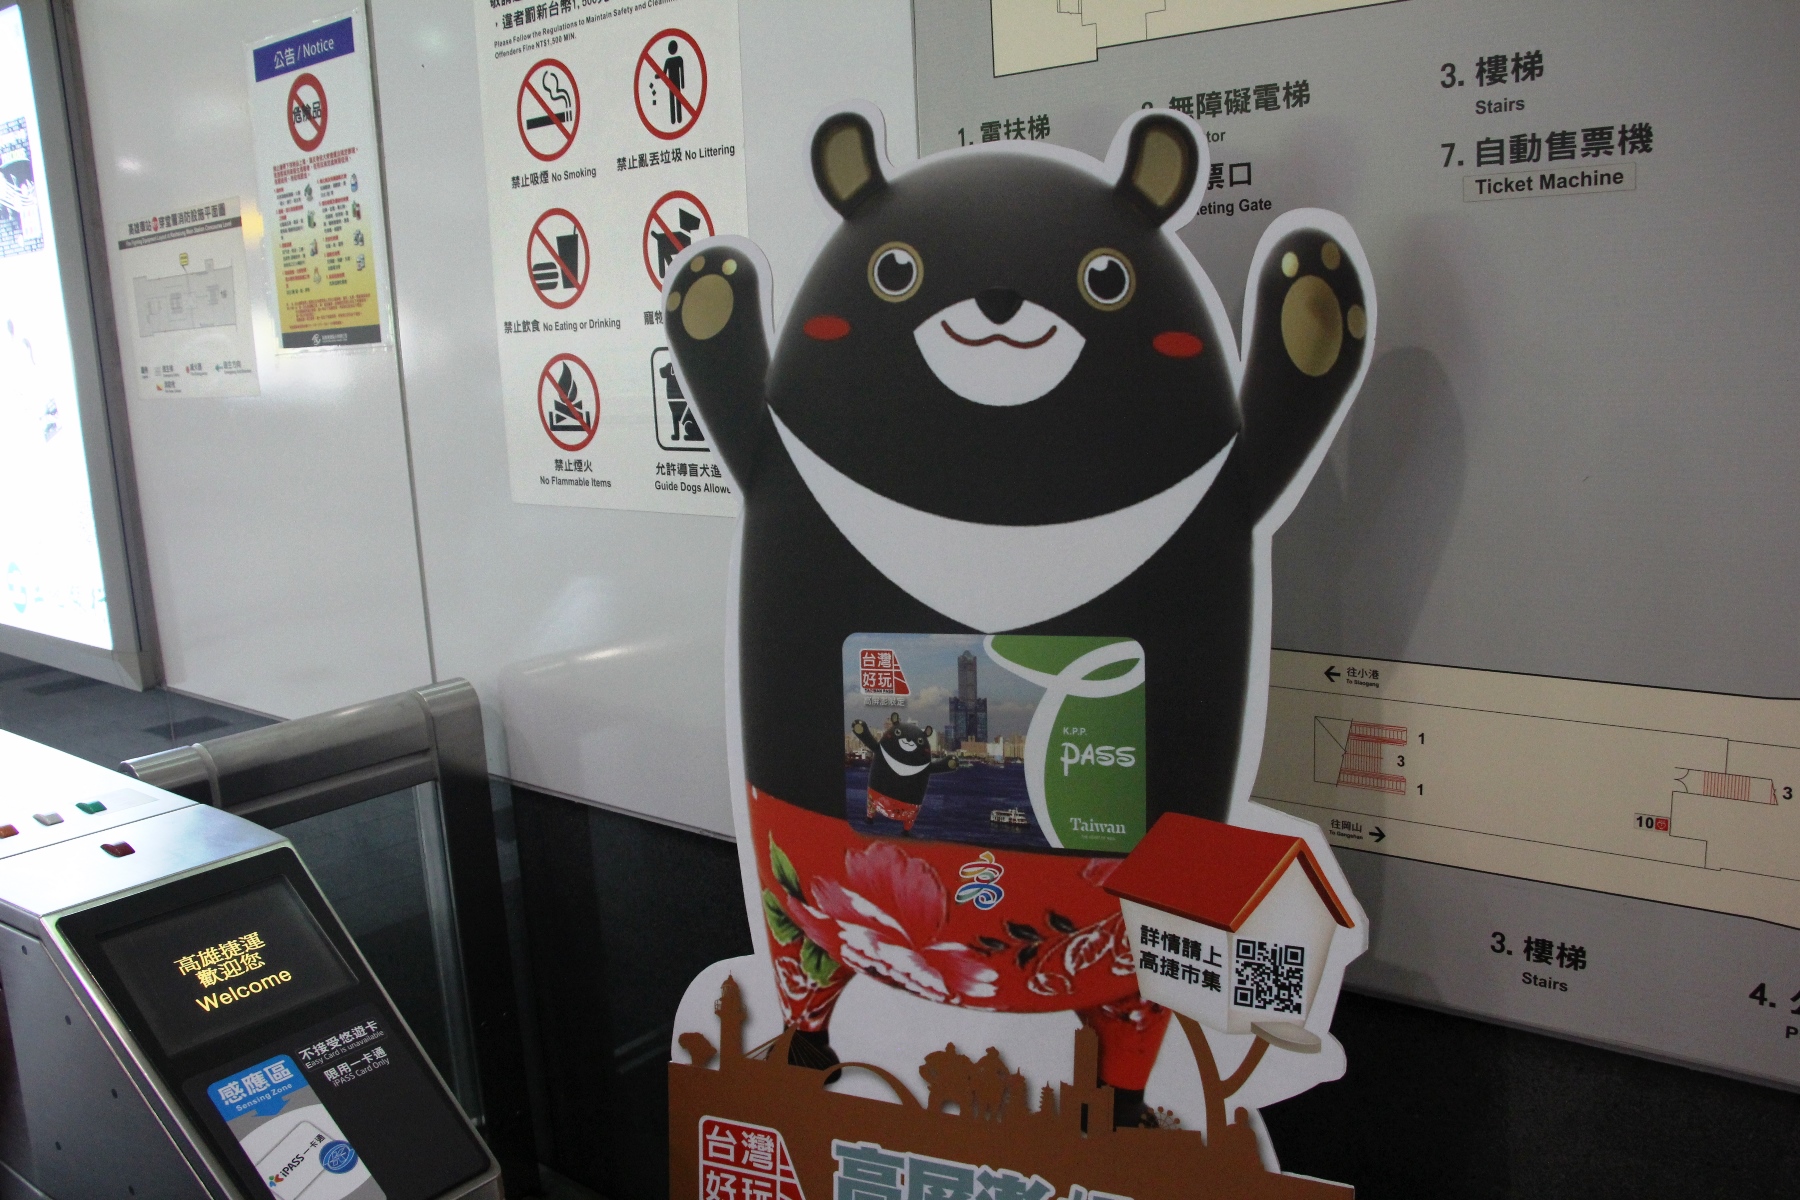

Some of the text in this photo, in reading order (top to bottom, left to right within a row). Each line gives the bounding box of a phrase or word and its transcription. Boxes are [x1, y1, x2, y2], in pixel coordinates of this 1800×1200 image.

[494, 38, 512, 48] Please
[513, 33, 531, 43] Follow
[542, 21, 577, 35] Regulations
[586, 12, 612, 24] Maintain
[613, 7, 633, 17] Safety
[635, 2, 646, 11] and
[274, 47, 295, 70] 公告
[303, 38, 334, 58] Notice
[494, 32, 577, 59] Offenders Fine NT$1,500 MIN.
[1440, 50, 1544, 89] 3. 樓梯
[1169, 79, 1311, 122] 無障礙電梯
[1475, 98, 1526, 115] Stairs
[616, 145, 735, 172] 禁止亂丟垃圾 No Littering
[1440, 122, 1654, 168] 7. 自動售票機
[511, 167, 597, 189] 禁止吸煙 No Smoking
[1207, 162, 1252, 190] 票口
[1475, 170, 1624, 195] Ticket Machine
[1197, 198, 1272, 217] eting Gate
[504, 318, 621, 334] 禁止飲食 No Eating or Drinking
[554, 459, 593, 473] 禁止煙火
[540, 476, 612, 488] No Flammable Items
[655, 480, 678, 491] Guide
[680, 481, 701, 493] Dogs
[863, 652, 891, 668] 台灣
[1347, 667, 1379, 680] 往小港
[863, 672, 892, 687] 好玩
[1354, 680, 1380, 688] Siaogang
[1063, 727, 1088, 736] K.P.P.
[1418, 733, 1425, 744] 1
[1060, 742, 1136, 777] PASS
[1397, 755, 1405, 767] 3
[1417, 784, 1423, 795] 1
[1782, 787, 1793, 800] 3
[1070, 818, 1126, 834] Taiwan
[1331, 819, 1362, 833] 往岡山
[1636, 816, 1654, 829] 10
[173, 931, 266, 976] 高雄捷運
[1140, 925, 1222, 968] 詳情請上
[1490, 931, 1587, 971] 3. 樓梯
[195, 952, 266, 989] 歡迎您
[1139, 950, 1222, 992] 高捷市集
[1522, 972, 1568, 992] Stairs
[195, 970, 292, 1012] Welcome
[1749, 983, 1776, 1008] 4.
[298, 1020, 378, 1060] 不接受悠遊卡
[305, 1059, 323, 1070] Easy
[323, 1050, 340, 1060] Card
[347, 1030, 384, 1050] unavailable
[323, 1046, 387, 1082] 限用一卡通
[332, 1057, 390, 1087] iPASS Card Only
[218, 1060, 294, 1106] 感應區
[236, 1083, 293, 1112] Sensing Zone
[279, 1154, 305, 1178] iPASS
[303, 1133, 326, 1155] 一卡通
[706, 1125, 775, 1171] 台灣
[706, 1170, 773, 1200] 好玩
